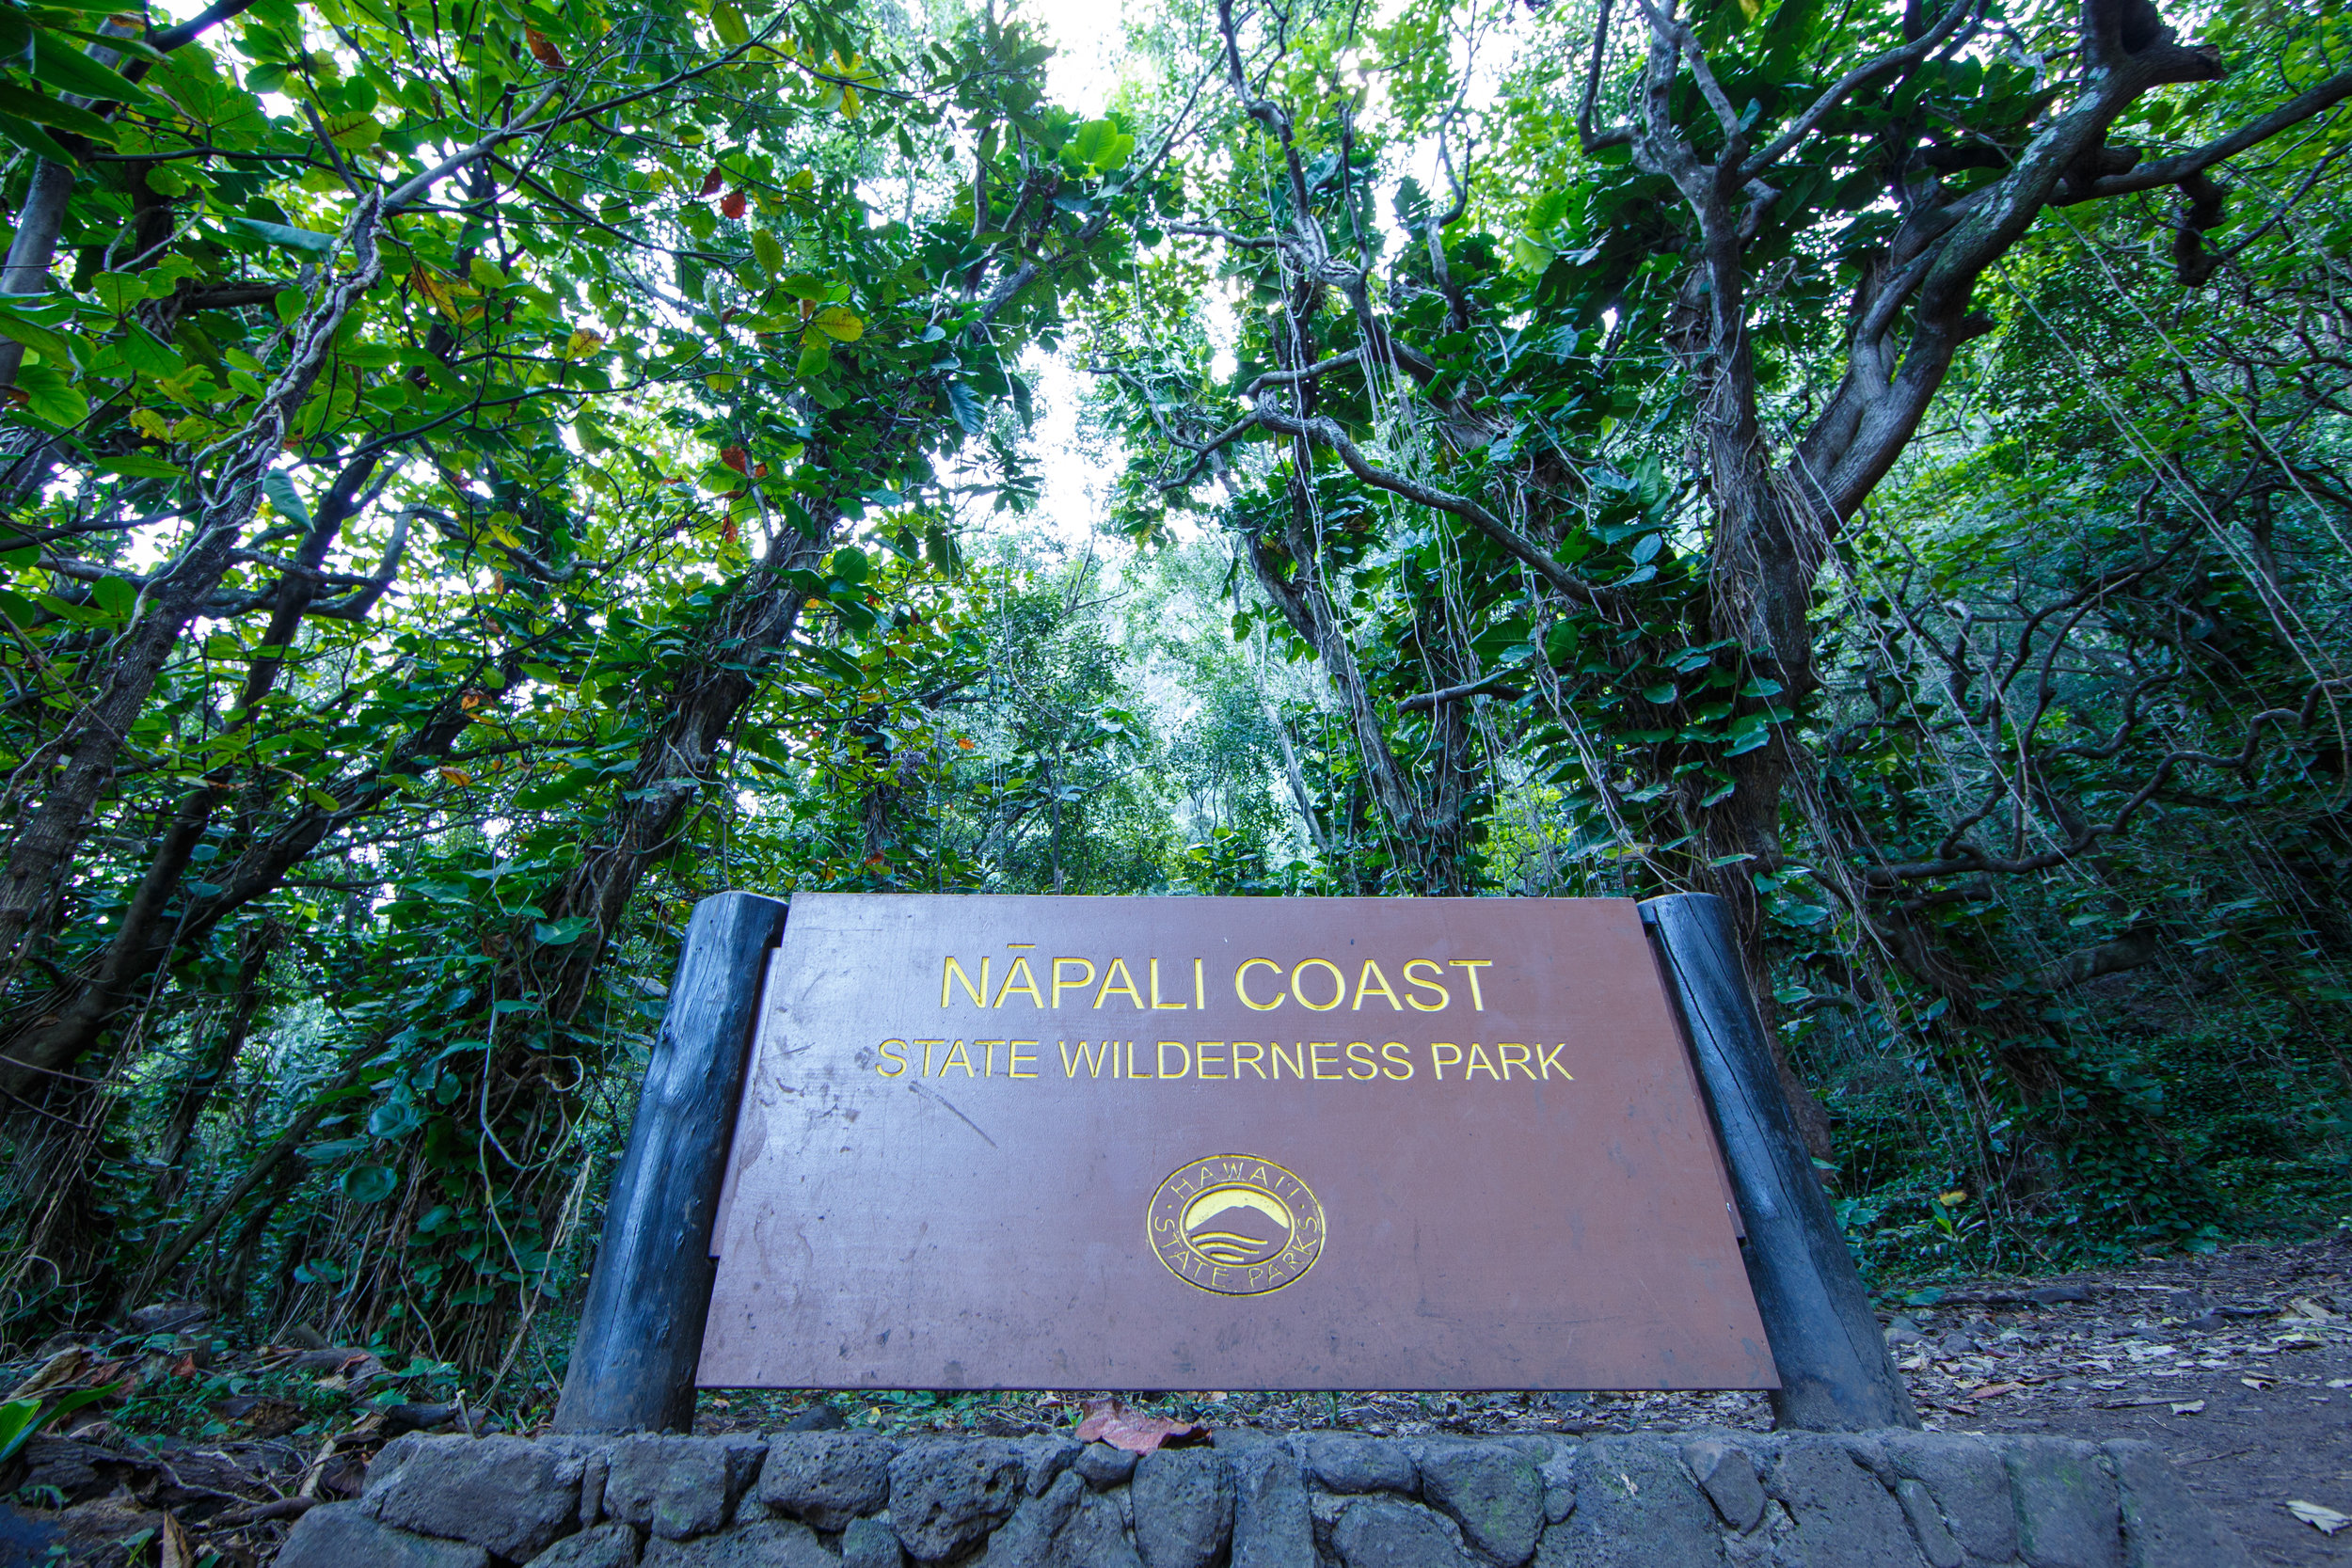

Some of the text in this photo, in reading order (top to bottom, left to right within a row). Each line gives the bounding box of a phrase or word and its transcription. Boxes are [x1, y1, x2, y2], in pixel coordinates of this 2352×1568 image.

[941, 943, 1493, 1012] NĀPALI COAST
[875, 1038, 1576, 1082] STATE WILDERNESS PARK
[1154, 1216, 1318, 1288] STATE PARKS
